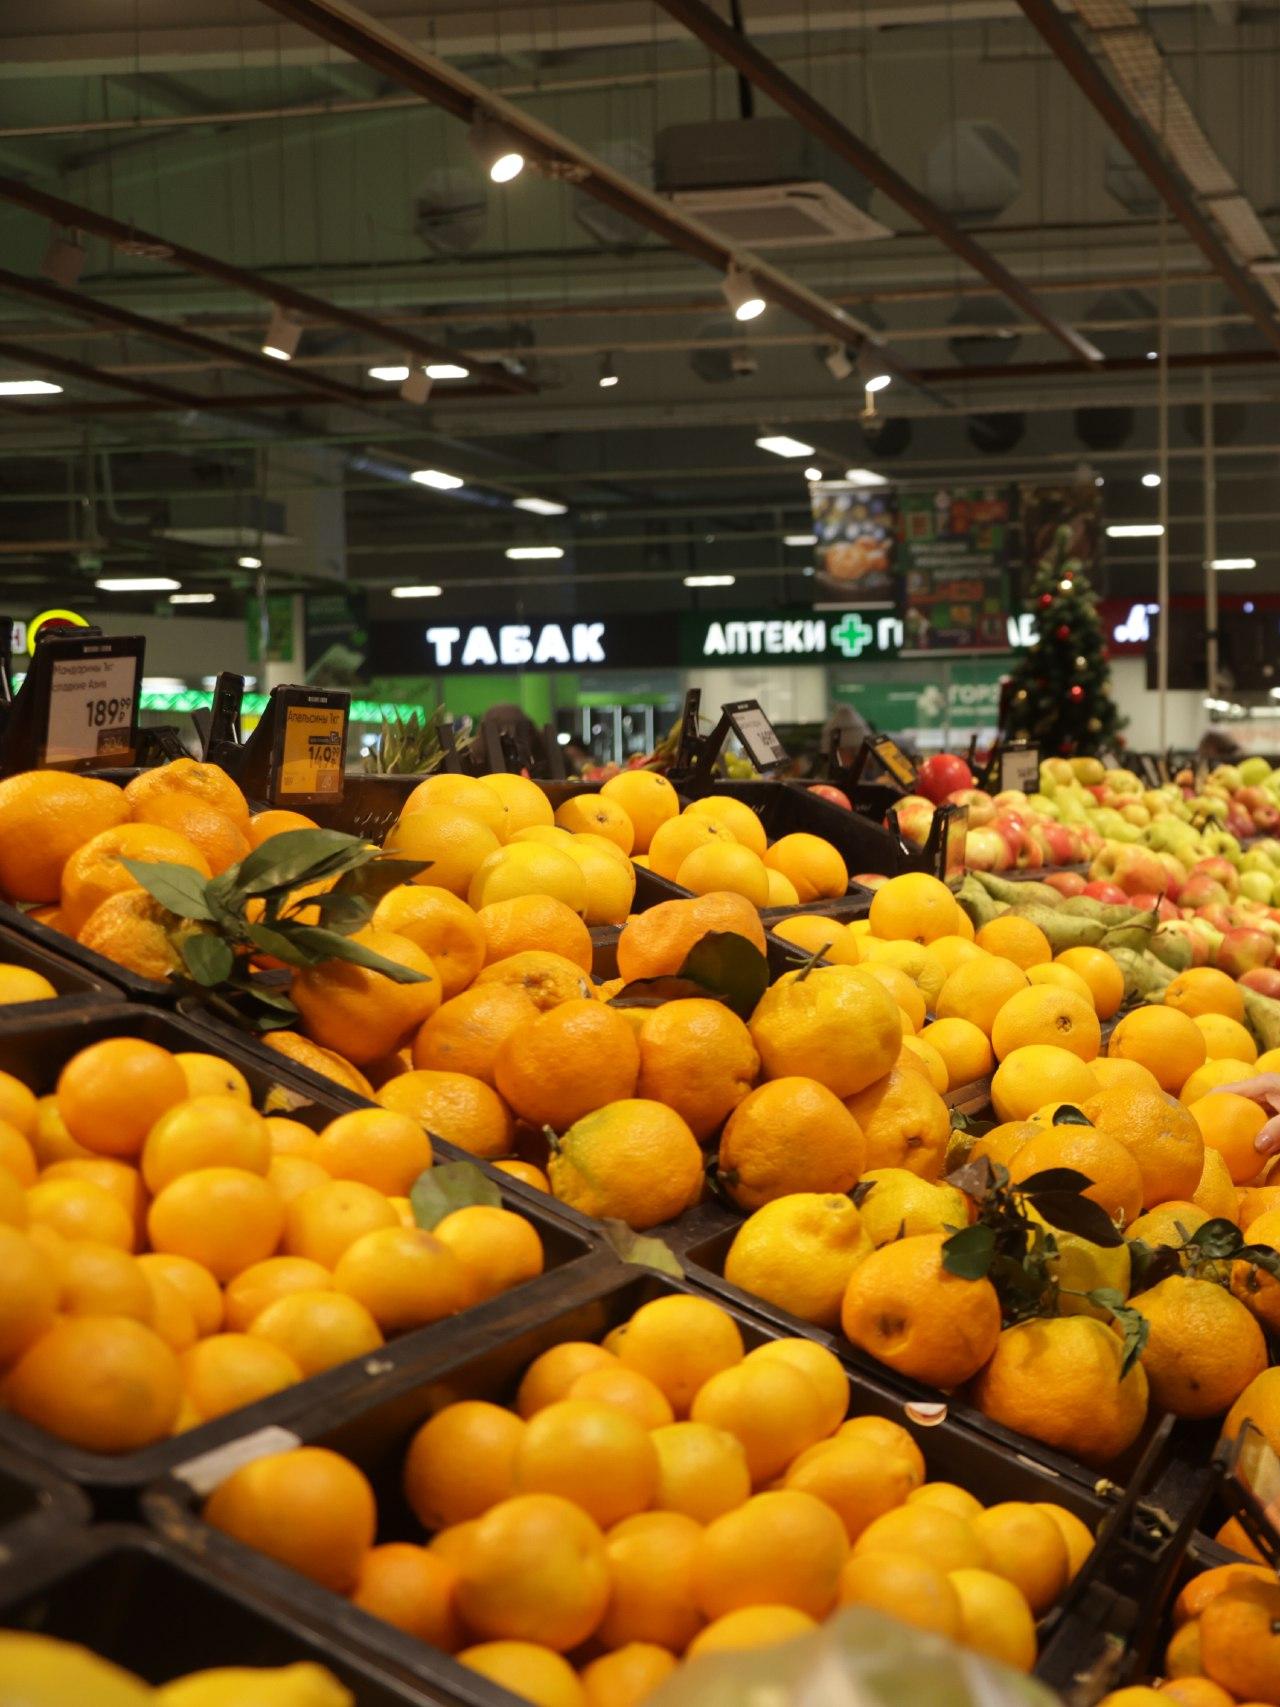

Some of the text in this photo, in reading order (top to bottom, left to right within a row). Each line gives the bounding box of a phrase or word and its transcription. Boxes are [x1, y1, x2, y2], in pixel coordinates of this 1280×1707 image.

[426, 622, 605, 666] ТАБАК
[703, 620, 826, 656] АПТЕКИ
[86, 699, 119, 727] 189
